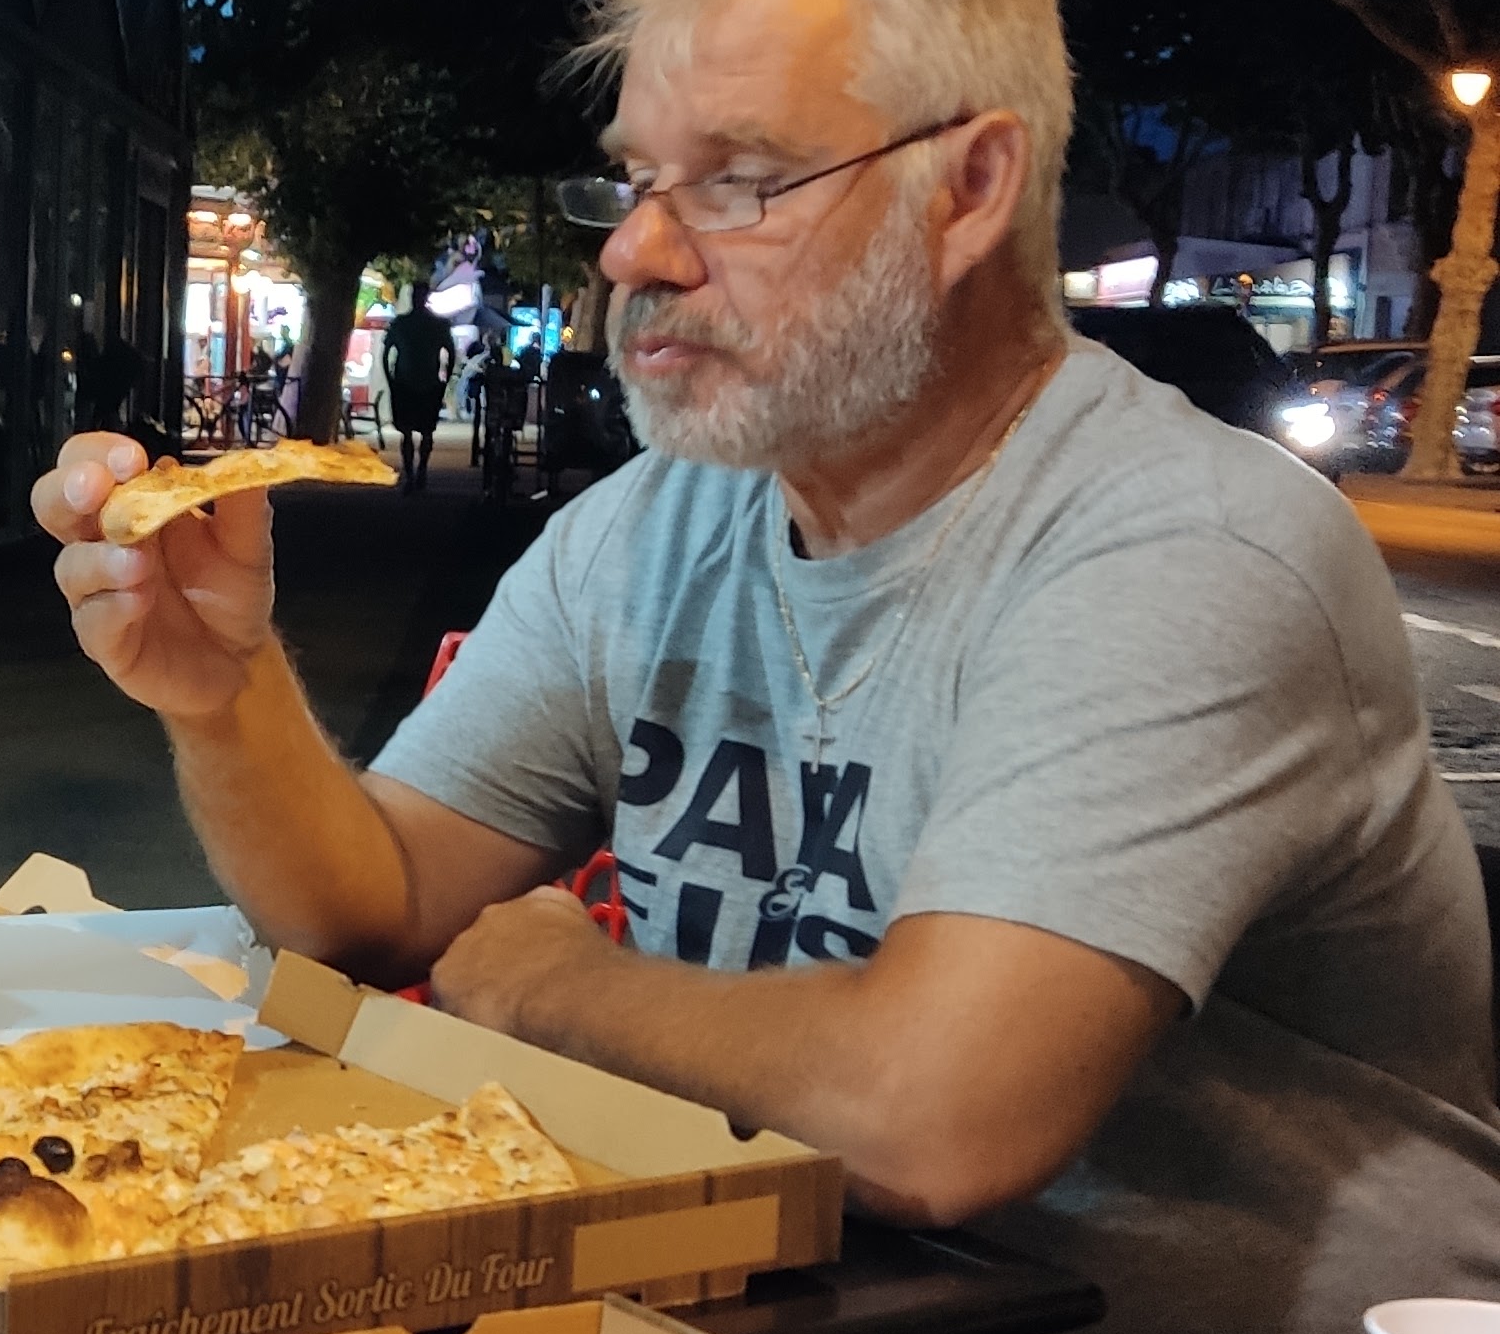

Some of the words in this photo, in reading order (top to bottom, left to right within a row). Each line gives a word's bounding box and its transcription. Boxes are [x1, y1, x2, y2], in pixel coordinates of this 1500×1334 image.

[313, 1272, 413, 1324] Sortie
[424, 1261, 472, 1304] Du
[481, 1252, 556, 1294] Four
